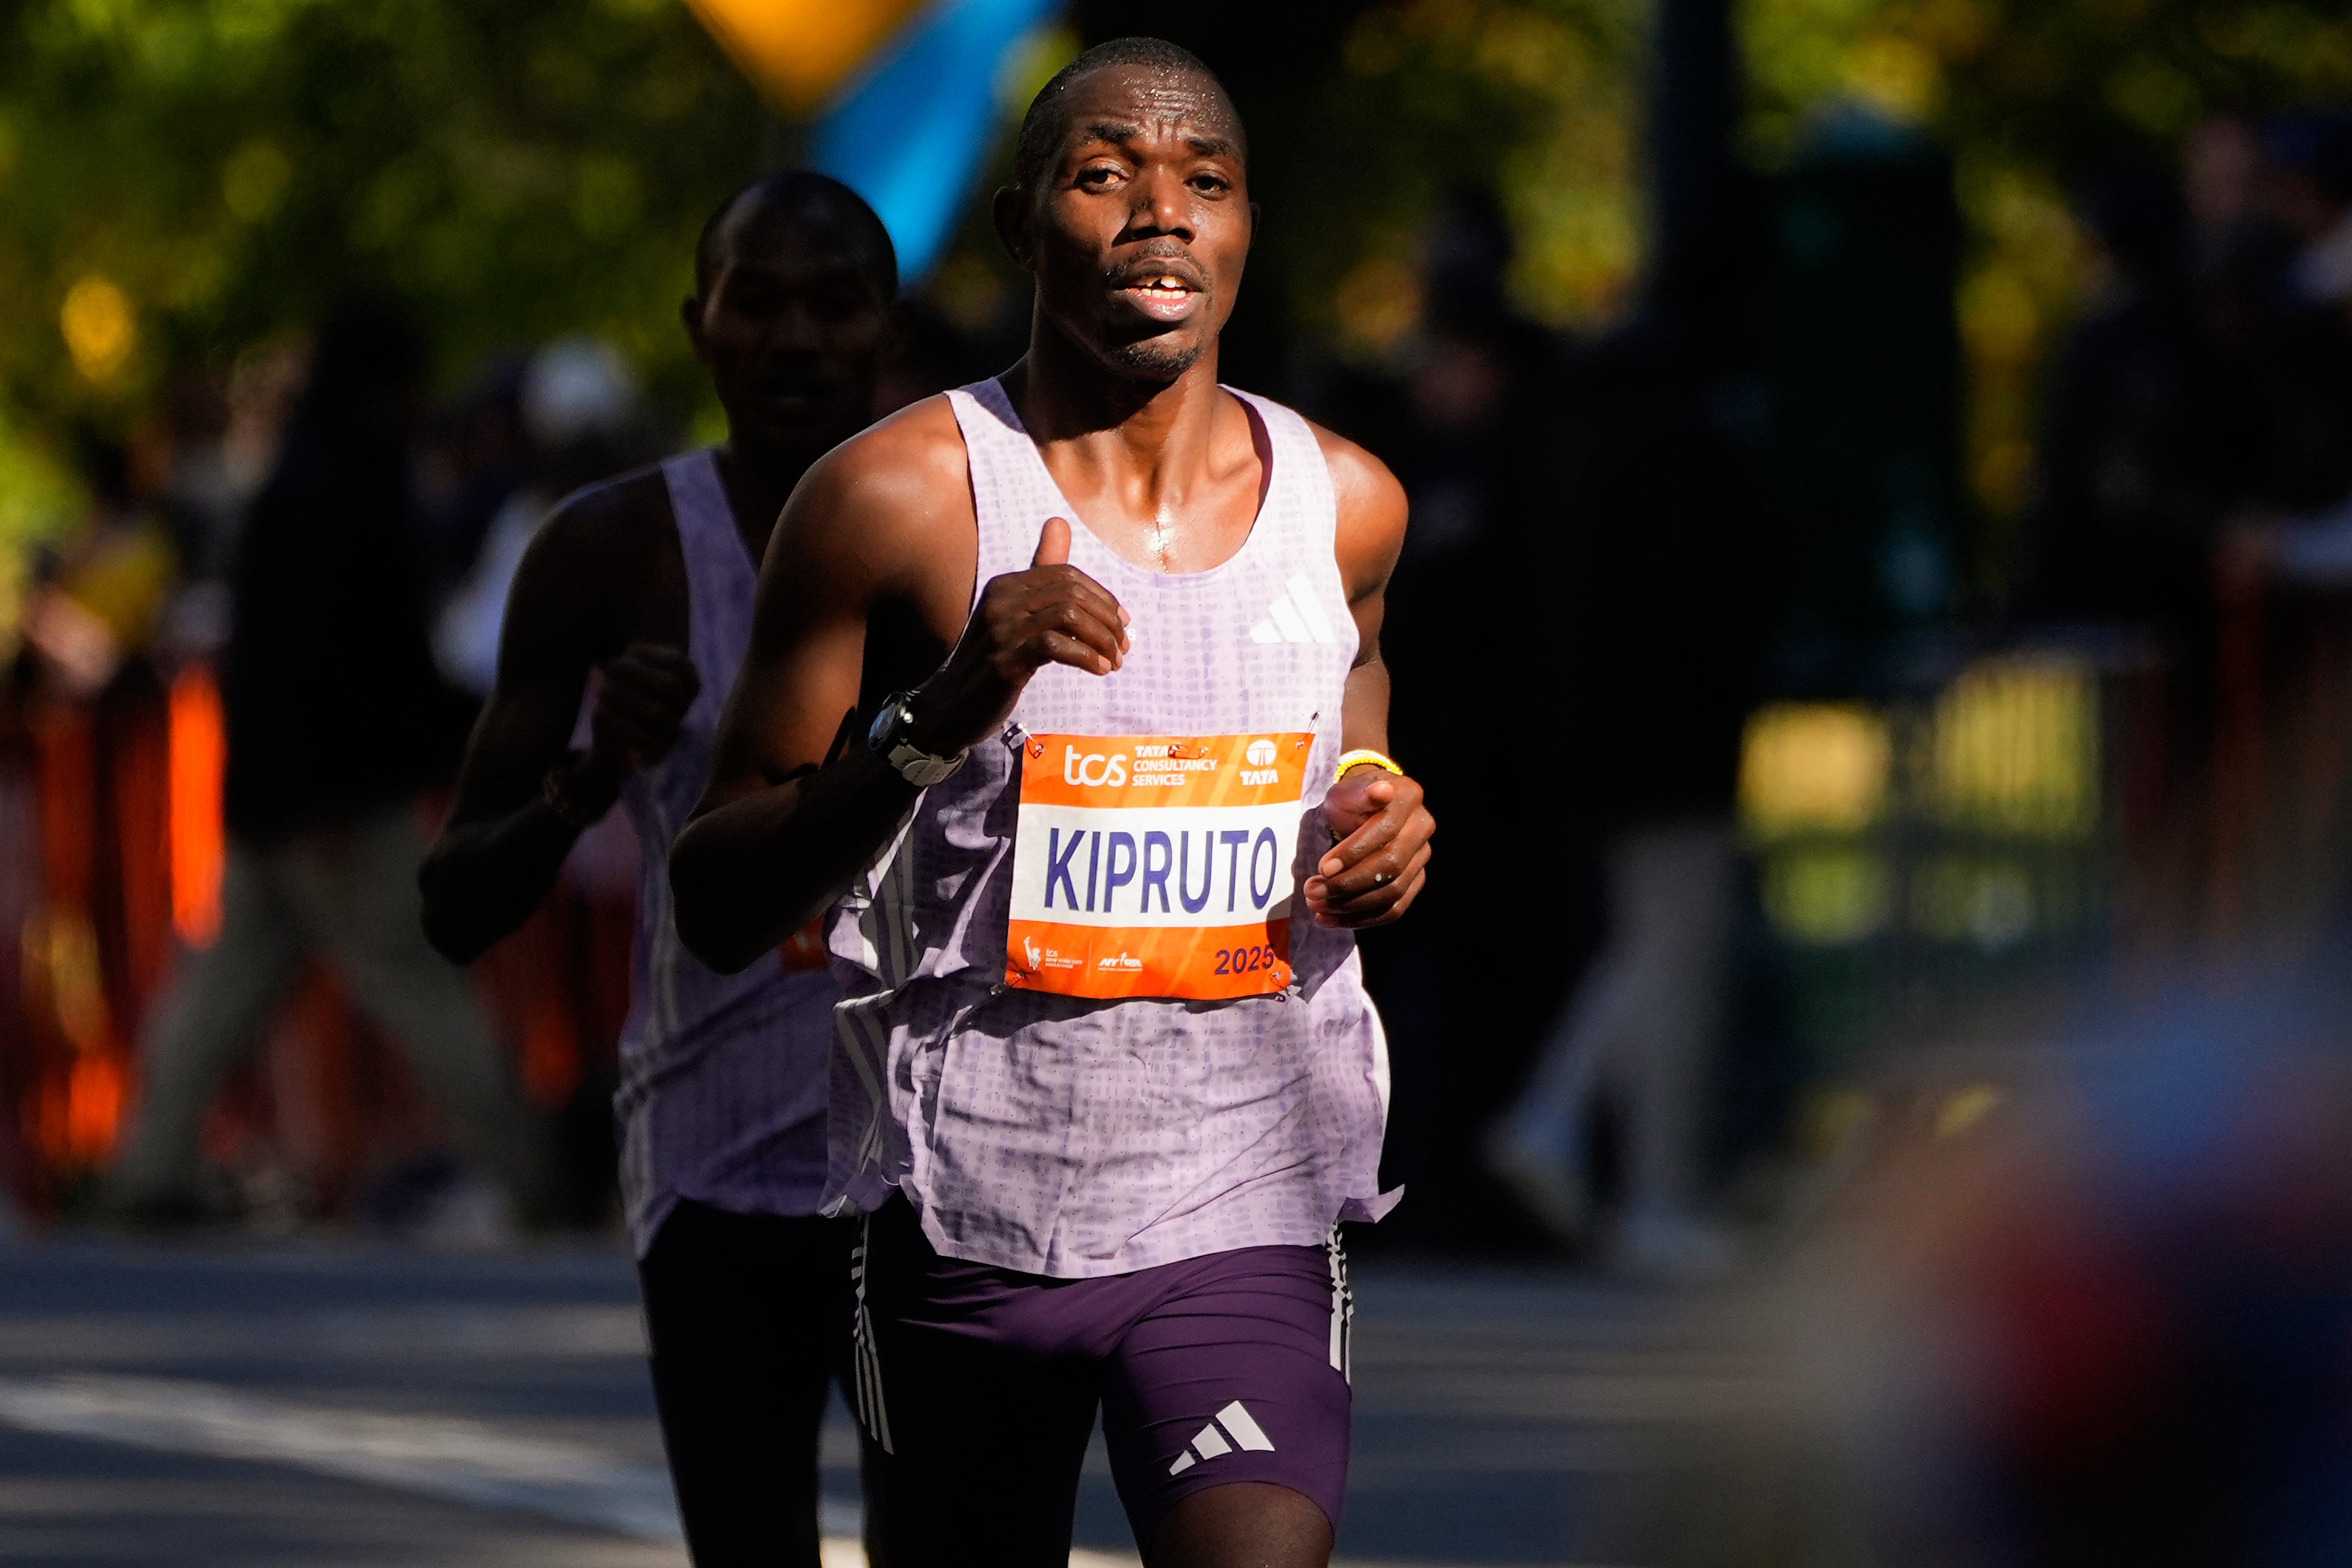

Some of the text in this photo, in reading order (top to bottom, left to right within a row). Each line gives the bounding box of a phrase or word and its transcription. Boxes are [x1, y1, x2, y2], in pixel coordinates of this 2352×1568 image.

[1133, 745, 1169, 757] TATA
[1064, 744, 1127, 787] tcs
[1133, 759, 1218, 772] CONSULTANCY
[1132, 774, 1185, 787] SERVICES
[1239, 769, 1278, 786] TATA
[1044, 827, 1277, 914] KIPRUTO
[1215, 944, 1275, 974] 2025
